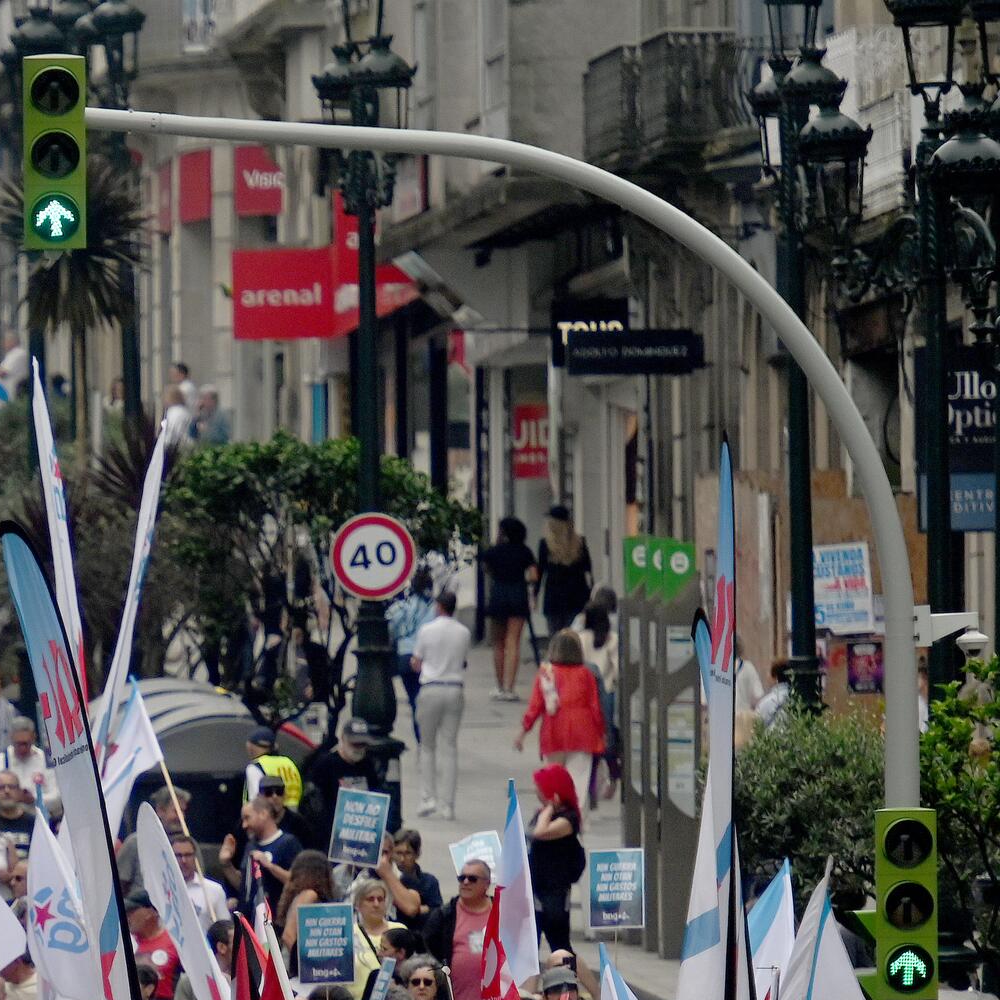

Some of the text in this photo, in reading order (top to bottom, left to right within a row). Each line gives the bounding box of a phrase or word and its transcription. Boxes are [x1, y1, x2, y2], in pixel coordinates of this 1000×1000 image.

[241, 282, 322, 309] arenal
[350, 541, 396, 569] 40
[345, 801, 381, 816] NON AO
[343, 813, 377, 829] DESFILE
[339, 827, 377, 843] MILITAR
[596, 862, 637, 872] NIN GUERRA
[600, 871, 633, 881] NIN OTAN
[596, 881, 637, 892] NIN GASTOS
[598, 891, 633, 902] MILITARES
[305, 917, 346, 927] NIN GUERRA
[310, 927, 342, 937] NIN OTAN
[305, 937, 347, 947] NIN GASTOS
[307, 947, 344, 958] MILITARES
